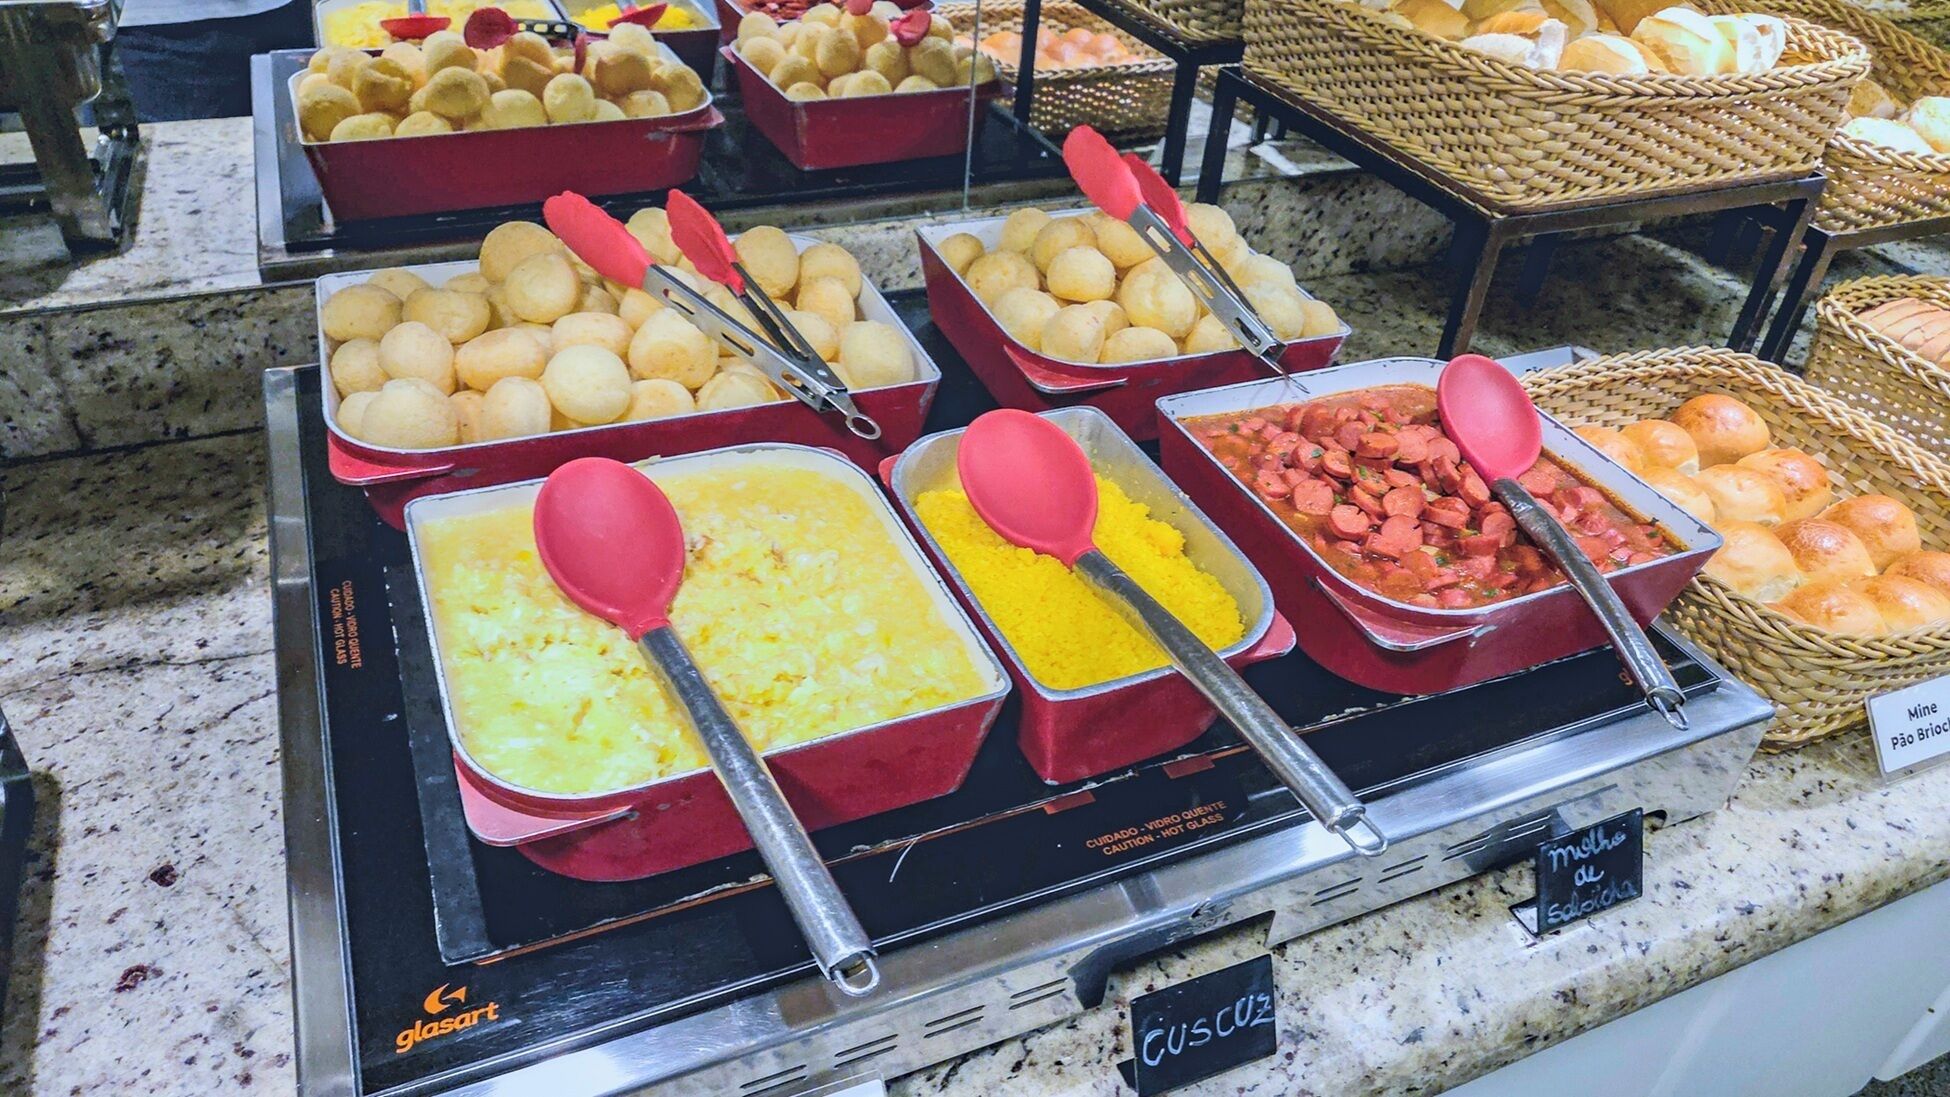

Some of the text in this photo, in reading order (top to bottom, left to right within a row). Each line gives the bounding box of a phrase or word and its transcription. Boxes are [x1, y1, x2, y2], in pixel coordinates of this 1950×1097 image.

[330, 588, 343, 619] CAUTION
[342, 580, 355, 611] CUIDADO
[334, 623, 345, 638] HOT
[346, 615, 358, 637] VIDRO
[335, 639, 348, 665] GLASS
[348, 639, 362, 669] QUENTE
[1907, 703, 1938, 721] Mine
[1891, 732, 1915, 750] Pão
[1086, 827, 1139, 849] CUIDADO
[1144, 814, 1181, 830] VIDRO
[1181, 801, 1227, 820] QUENTE
[1103, 834, 1155, 855] CAUTION
[1161, 824, 1185, 838] HOT
[1186, 813, 1224, 830] GLASS
[1574, 864, 1604, 886] de
[396, 1002, 499, 1053] glasart
[1142, 993, 1276, 1066] CUSCUZ
